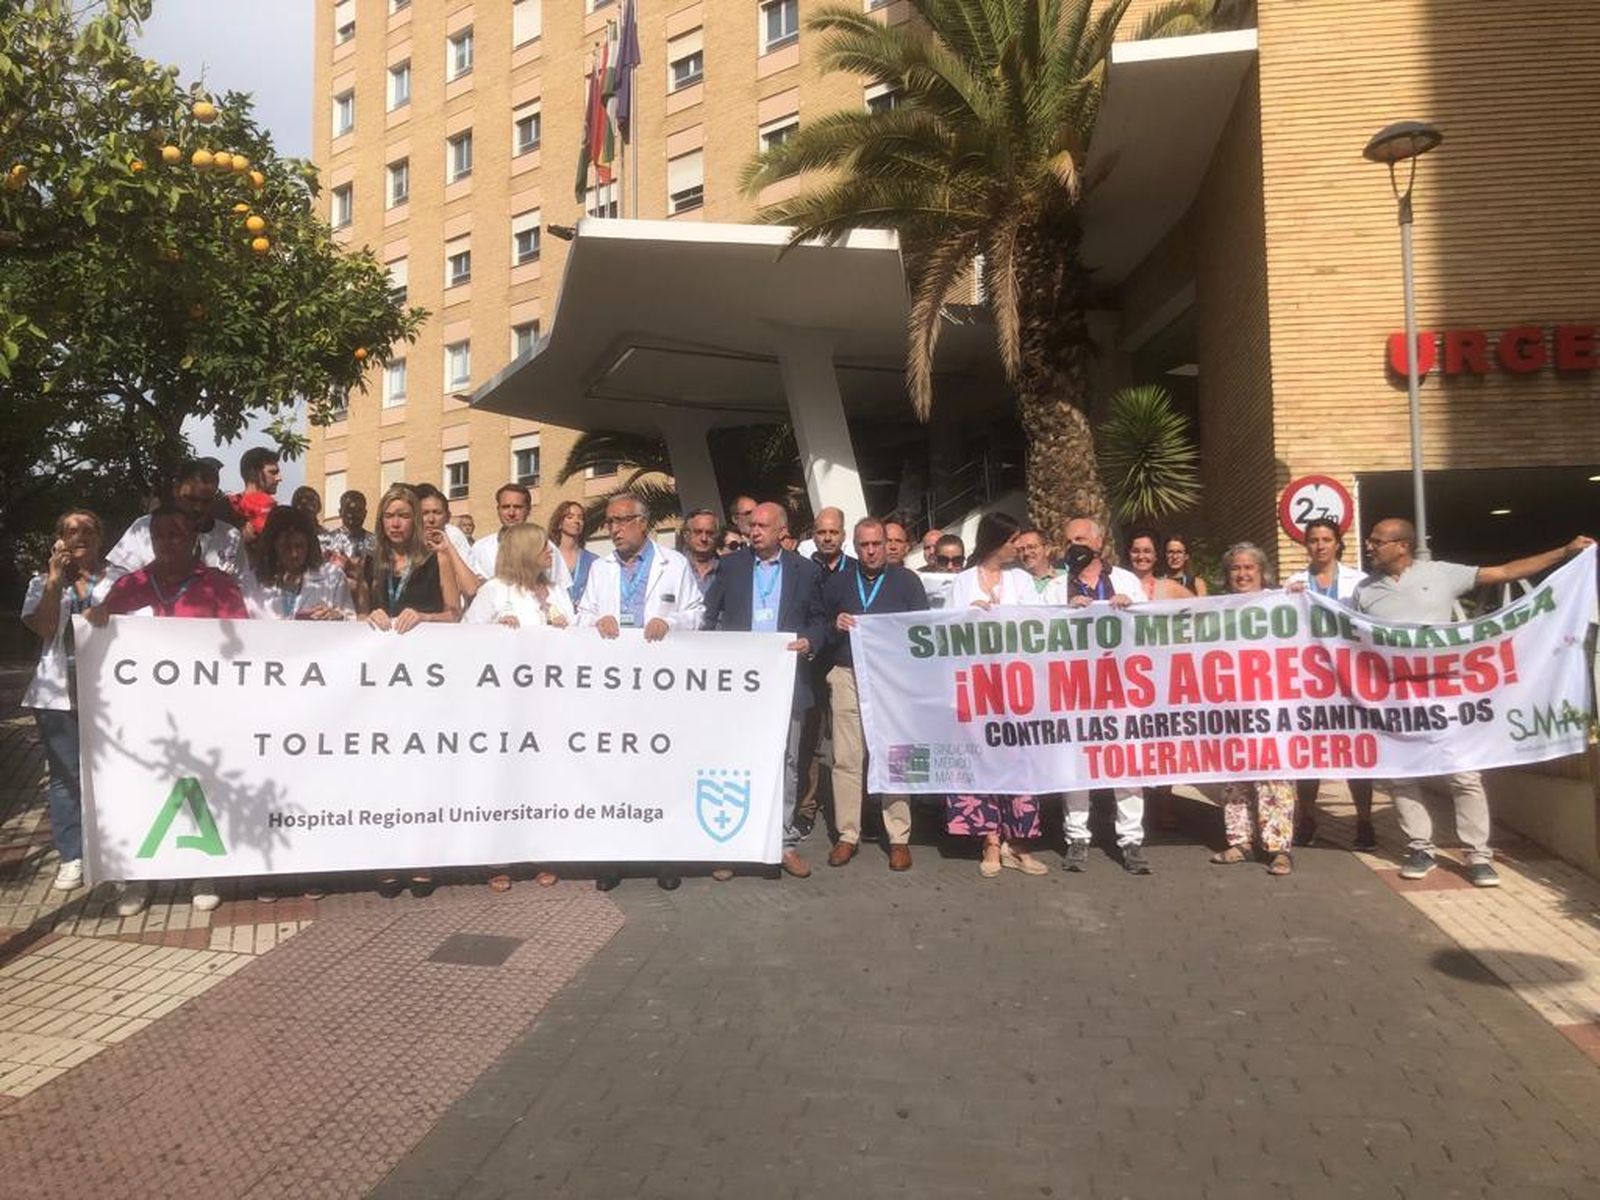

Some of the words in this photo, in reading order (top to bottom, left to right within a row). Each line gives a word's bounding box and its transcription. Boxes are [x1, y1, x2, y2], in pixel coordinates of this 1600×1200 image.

[1389, 324, 1600, 377] URGE
[908, 614, 1122, 659] SINDICATO
[1134, 605, 1298, 647] MÉDICO
[114, 659, 326, 686] CONTRA
[360, 661, 445, 688] LAS
[477, 663, 761, 692] AGRESIONES
[955, 661, 1034, 722] ¡NO
[1049, 652, 1155, 712] MÁS
[1168, 637, 1518, 706] AGRESIONES!
[254, 731, 540, 756] TOLERANCIA
[568, 731, 671, 754] CERO
[985, 718, 1071, 748] CONTRA
[1076, 713, 1118, 742] LAS
[1125, 707, 1271, 740] AGRESIONES
[1277, 708, 1294, 732] A
[1299, 698, 1494, 733] SANITARIAS-OS
[1084, 734, 1281, 779] TOLERANCIA
[1288, 733, 1377, 770] CERO
[268, 810, 353, 832] Hospital
[359, 809, 443, 831] Regional
[449, 803, 569, 823] Universitario
[574, 804, 596, 820] de
[601, 803, 664, 823] Málaga
